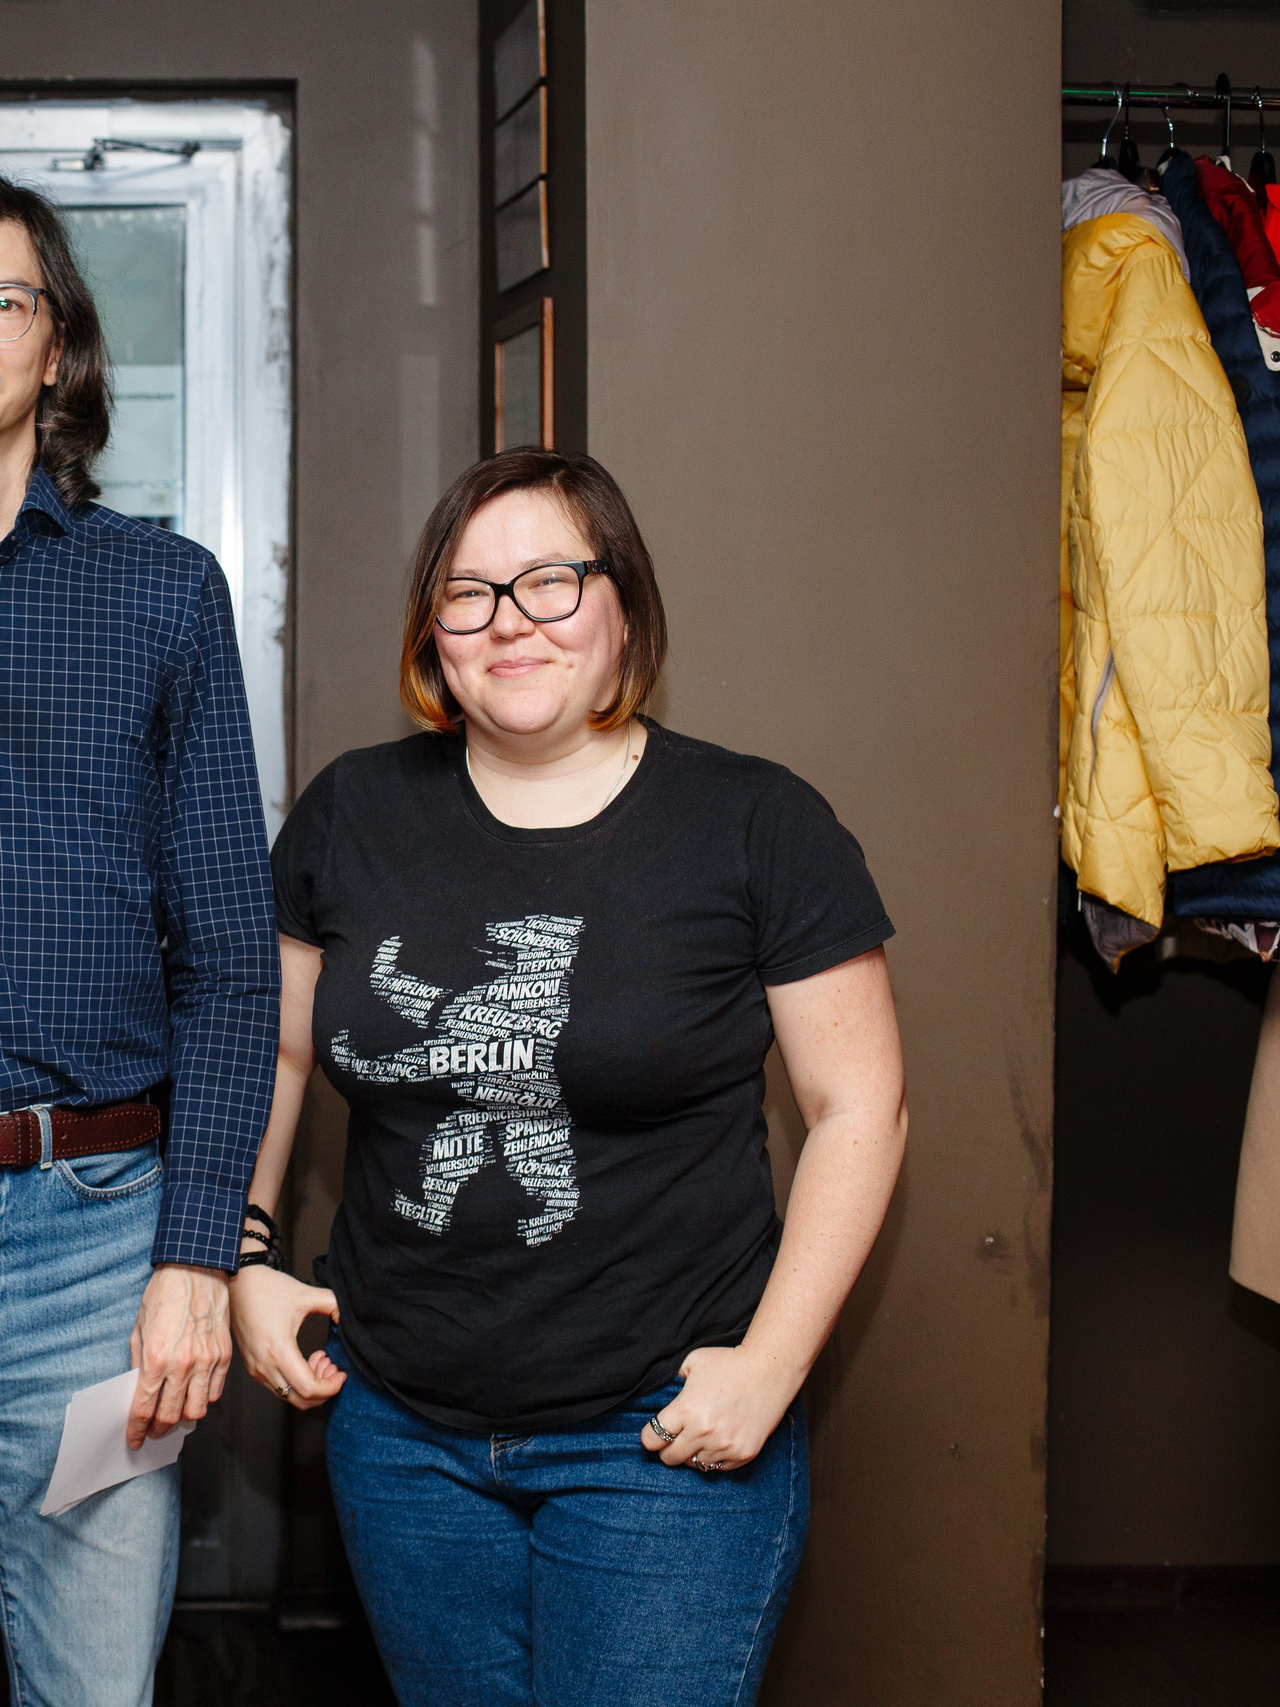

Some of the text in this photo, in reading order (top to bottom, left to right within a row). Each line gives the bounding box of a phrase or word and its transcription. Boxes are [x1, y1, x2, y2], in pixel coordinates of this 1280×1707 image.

[525, 919, 580, 936] LICHTENBERG
[495, 927, 573, 951] SCHÖNEBERG
[516, 956, 572, 974] TREPTOW
[517, 950, 551, 961] WEDDING
[510, 970, 565, 983] FRIEDRICHSHAIN
[378, 976, 443, 1000] TEMPELHOF
[485, 979, 561, 1001] PANKOW
[387, 994, 435, 1011] MARZAHN
[453, 994, 482, 1004] PANKOW
[400, 1008, 427, 1019] BERLIN
[458, 1003, 562, 1039] KREUZBERG
[444, 1019, 512, 1039] REINICKENDORF
[448, 1029, 491, 1043] ZEHLENDORF
[423, 1038, 455, 1047] KREUZBERG
[393, 1053, 429, 1065] STEGLITZ
[429, 1038, 535, 1076] BERLIN
[351, 1058, 419, 1079] WEDDING
[511, 1070, 549, 1080] NEUKÖLLN
[477, 1075, 561, 1096] CHARLOTTENBURG
[473, 1085, 558, 1109] NEUKÖLLN
[458, 1109, 549, 1127] FRIEDRICHSHAIN
[505, 1117, 572, 1140] SPANDAU
[433, 1130, 484, 1160] MITTE
[503, 1127, 571, 1156] ZEHLENDORF
[515, 1158, 572, 1177] KÖPENICK
[422, 1176, 460, 1195] BERLIN
[520, 1177, 574, 1188] HELLERSDORF
[424, 1191, 456, 1205] TREPTOW
[540, 1188, 580, 1199] SCHÖNEBERG
[394, 1199, 447, 1225] STEGLITZ
[528, 1208, 574, 1228] KREUZBERG
